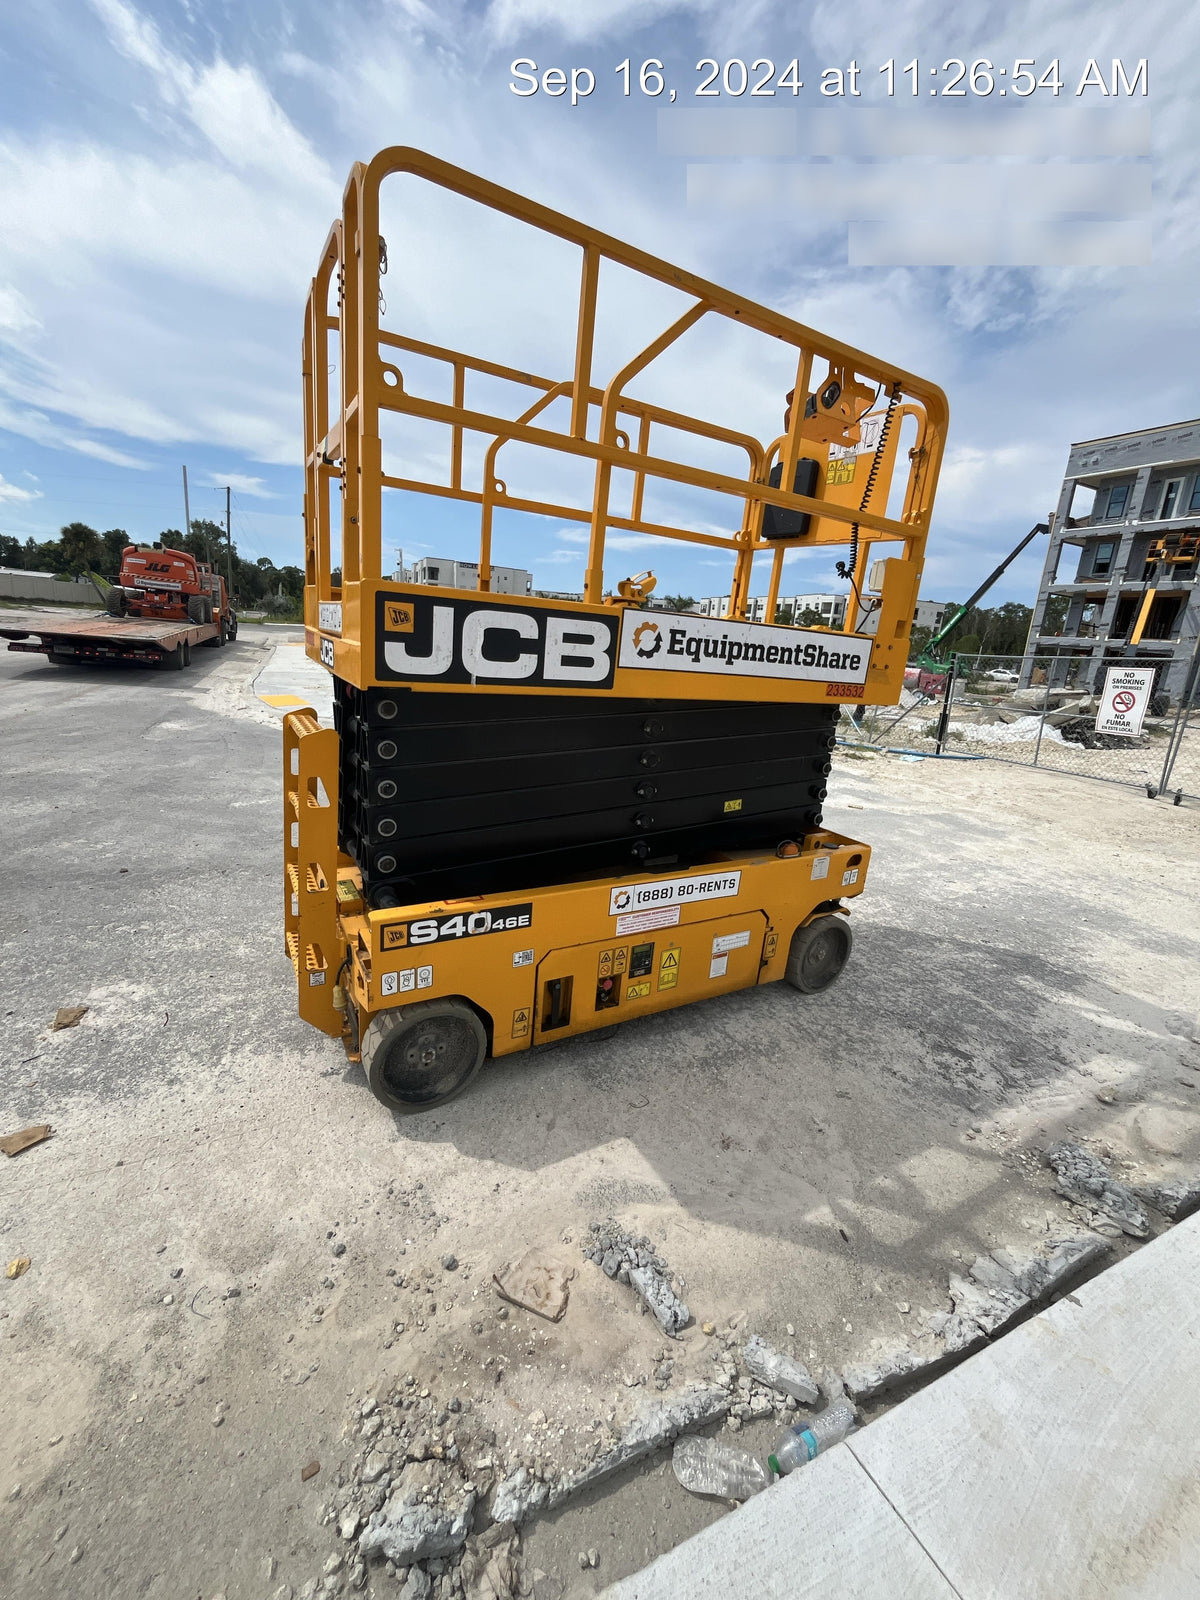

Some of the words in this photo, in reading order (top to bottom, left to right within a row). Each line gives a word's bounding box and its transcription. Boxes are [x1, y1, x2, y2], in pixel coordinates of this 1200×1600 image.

[144, 562, 171, 573] JLG
[392, 609, 411, 625] JCB
[320, 638, 334, 667] JCB
[384, 606, 612, 683] JCB
[667, 628, 861, 671] EquipmentShare
[1112, 678, 1145, 686] SMOKING
[826, 684, 865, 698] 233532
[1106, 719, 1131, 727] FUMAR
[637, 886, 674, 904] (888)
[678, 878, 736, 896] 80-RENTS
